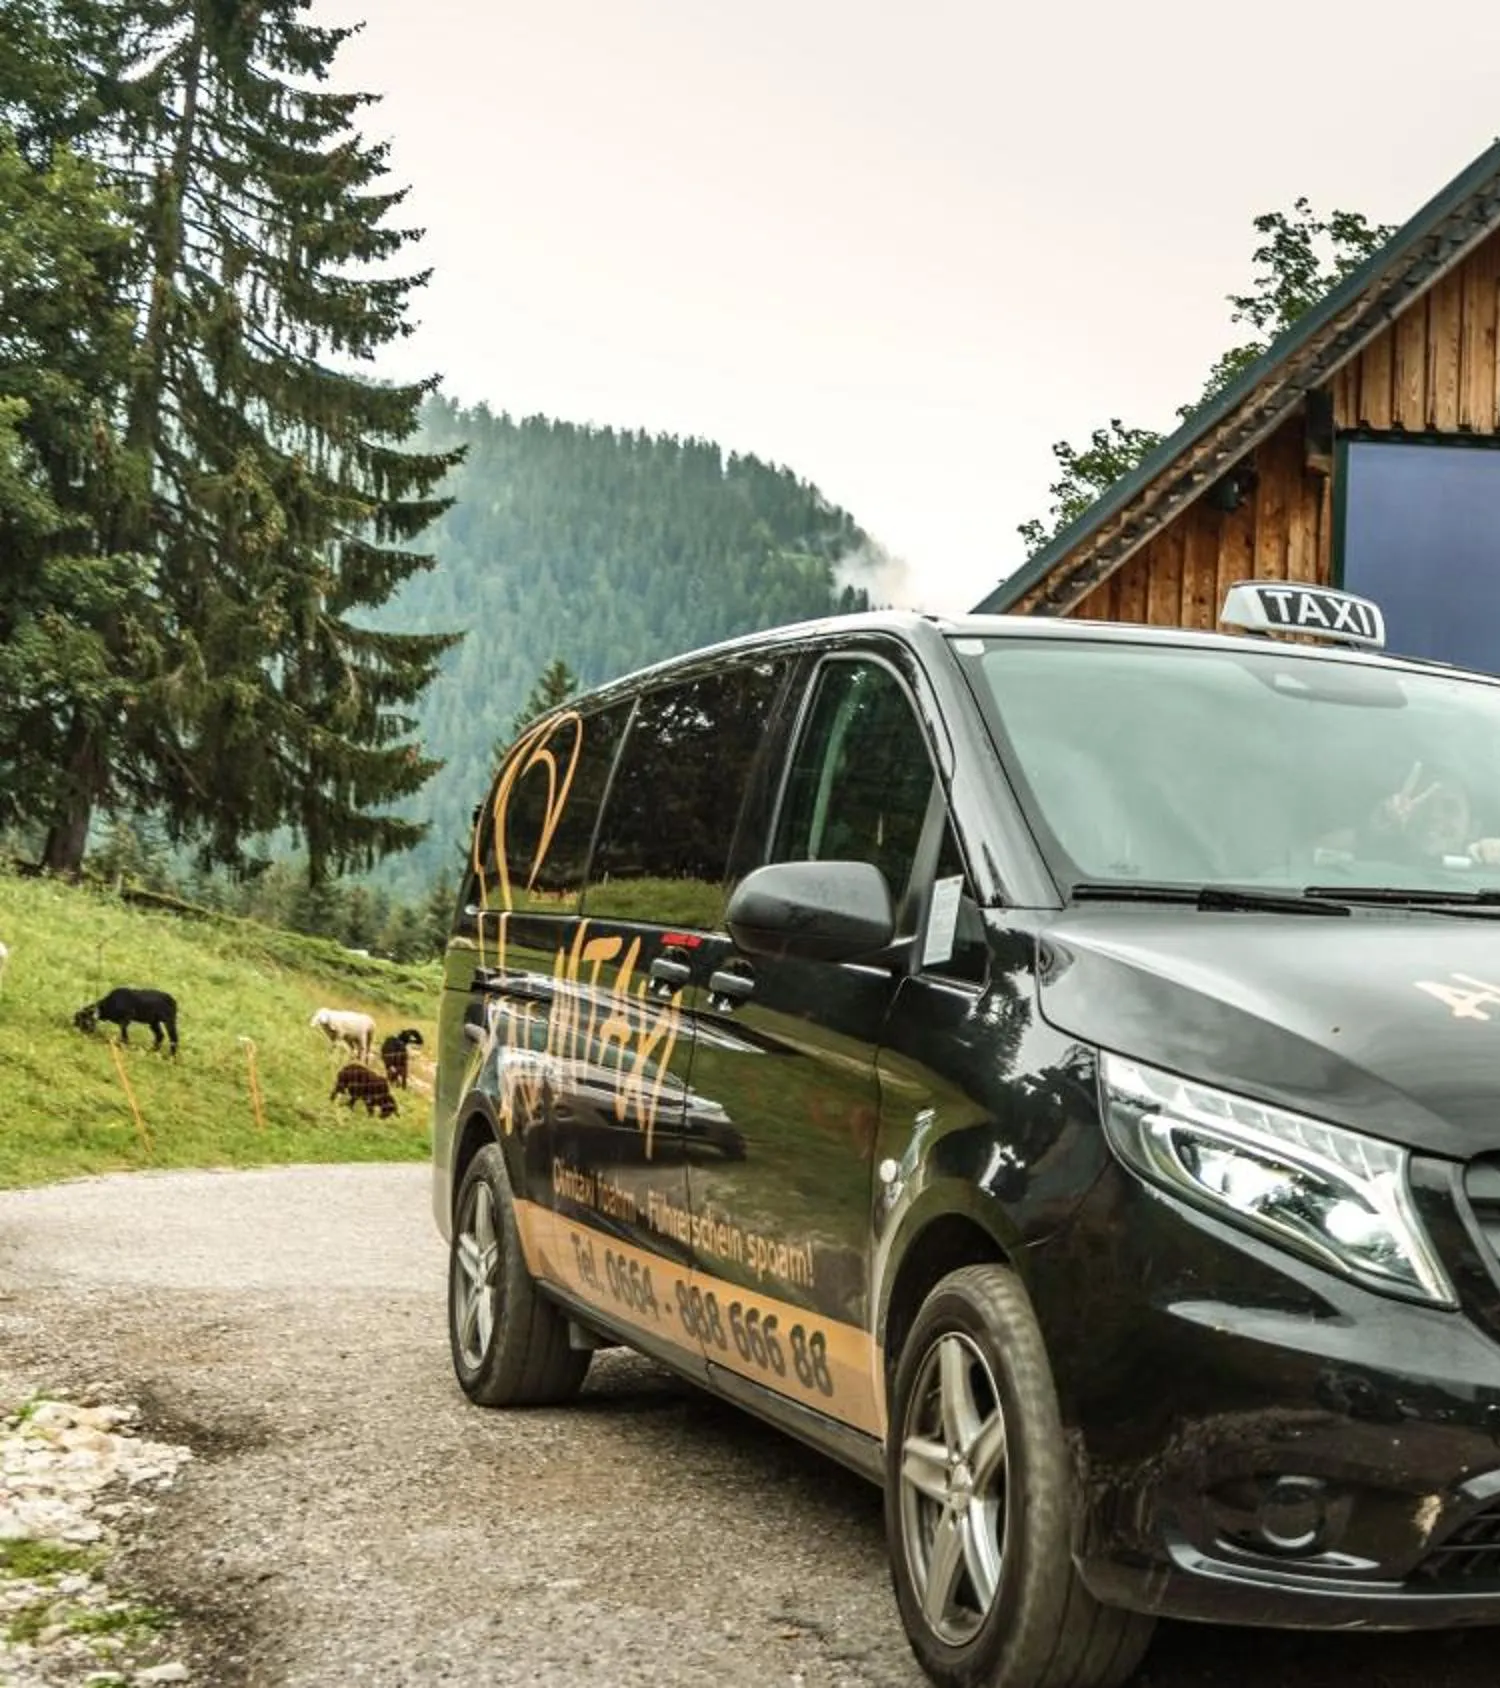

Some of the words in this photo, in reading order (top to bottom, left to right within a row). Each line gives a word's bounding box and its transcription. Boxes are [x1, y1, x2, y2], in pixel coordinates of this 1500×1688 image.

[1265, 591, 1373, 636] TAXI
[675, 1279, 728, 1351] 888
[729, 1301, 786, 1378] 666
[789, 1323, 834, 1398] 88
